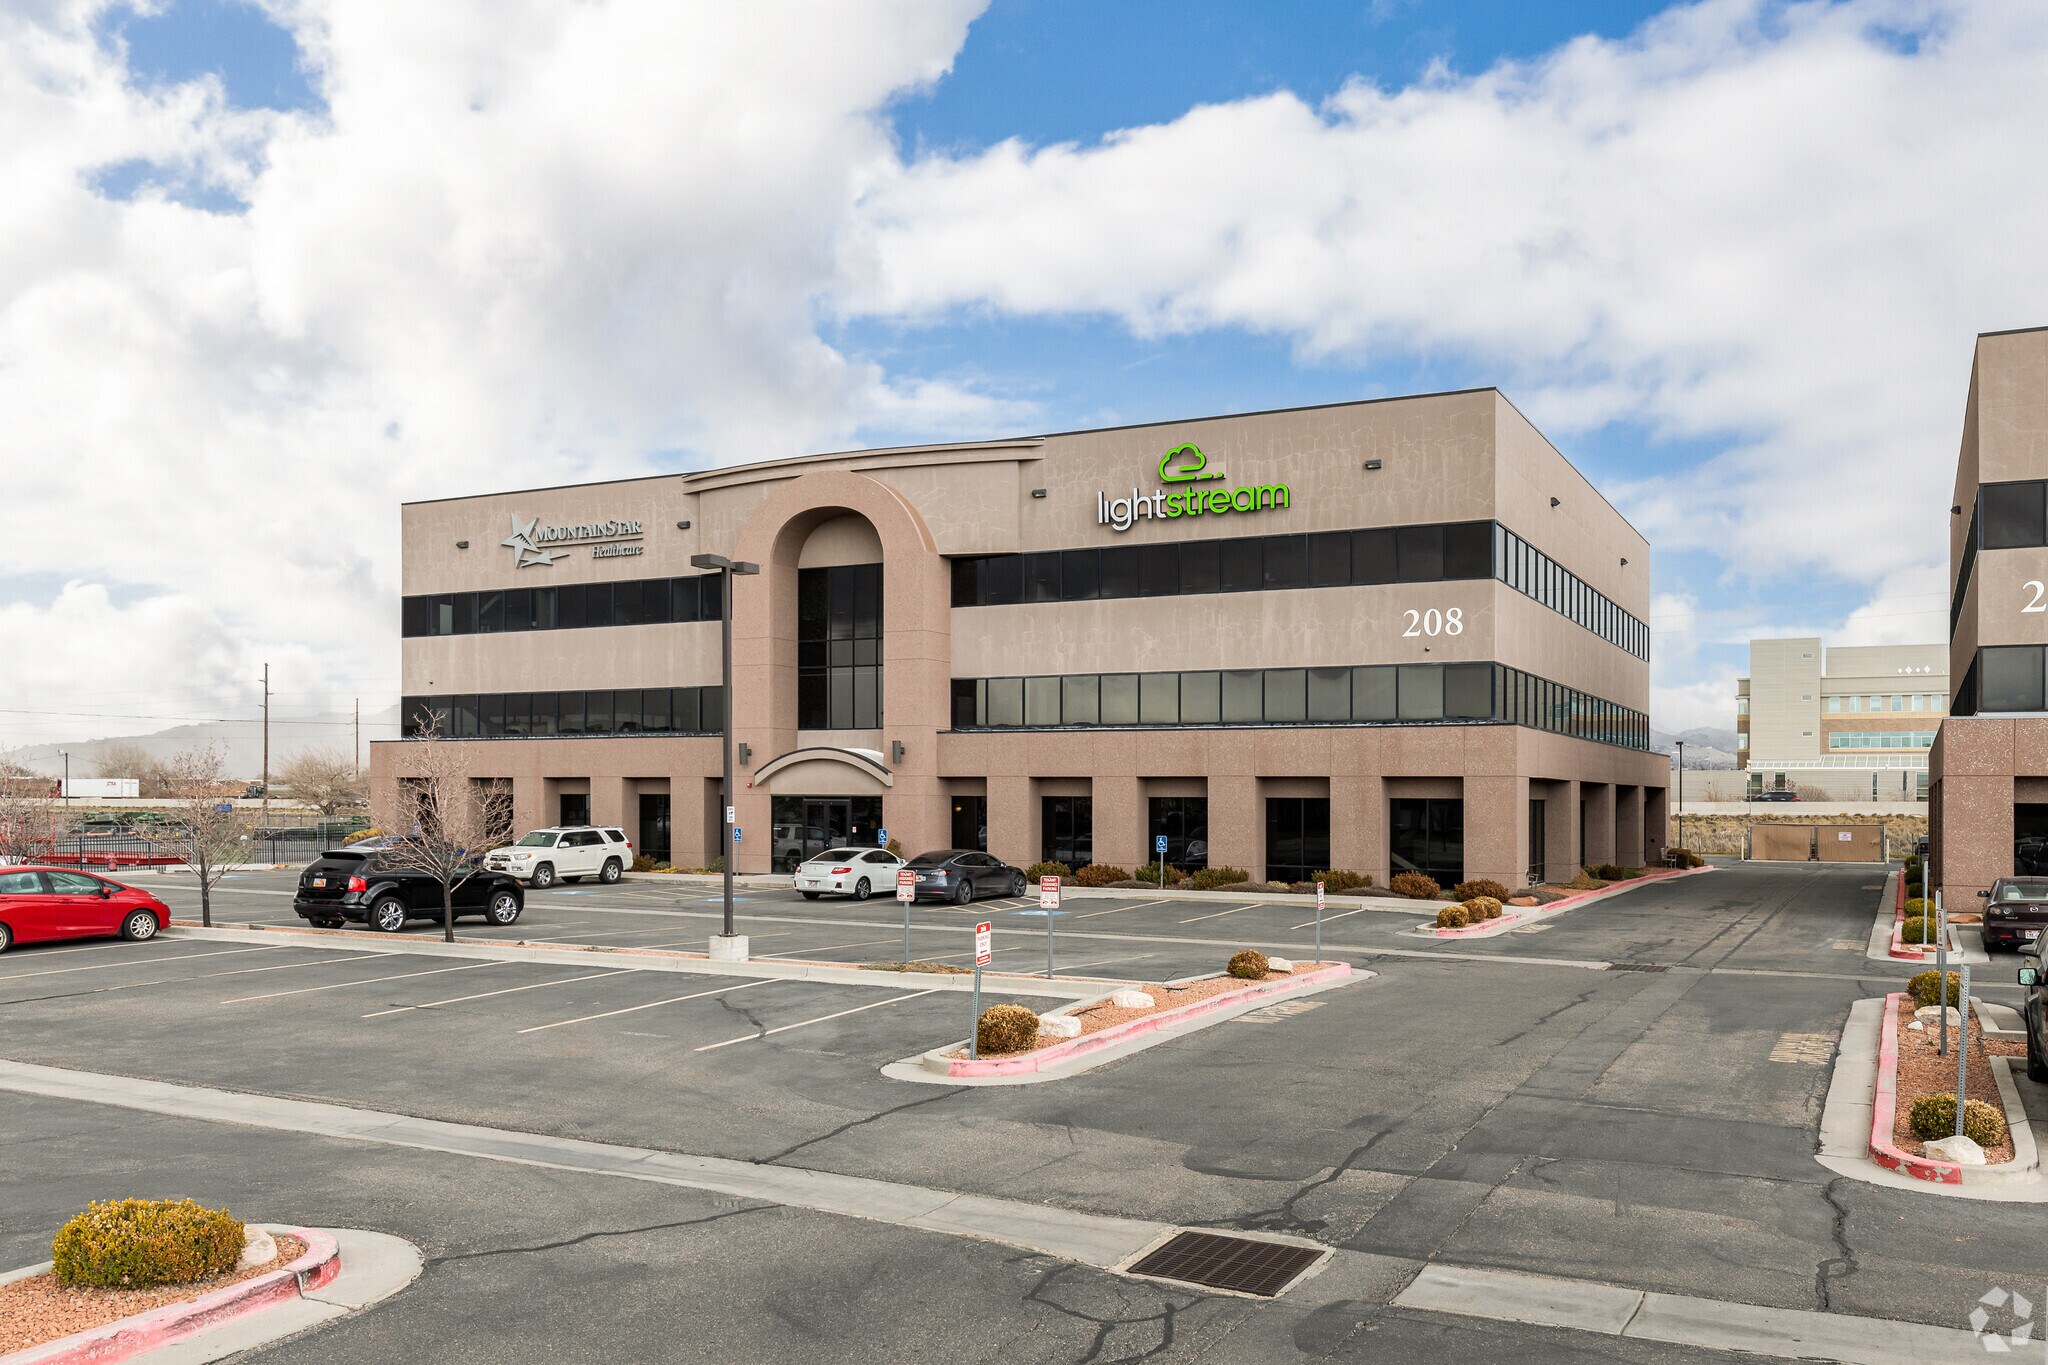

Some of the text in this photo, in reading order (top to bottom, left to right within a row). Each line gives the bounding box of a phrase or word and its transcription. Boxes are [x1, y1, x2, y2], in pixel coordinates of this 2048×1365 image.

[1097, 483, 1290, 531] lightstream
[592, 544, 643, 559] Healthcare
[2021, 580, 2047, 612] 2
[1402, 607, 1463, 637] 208
